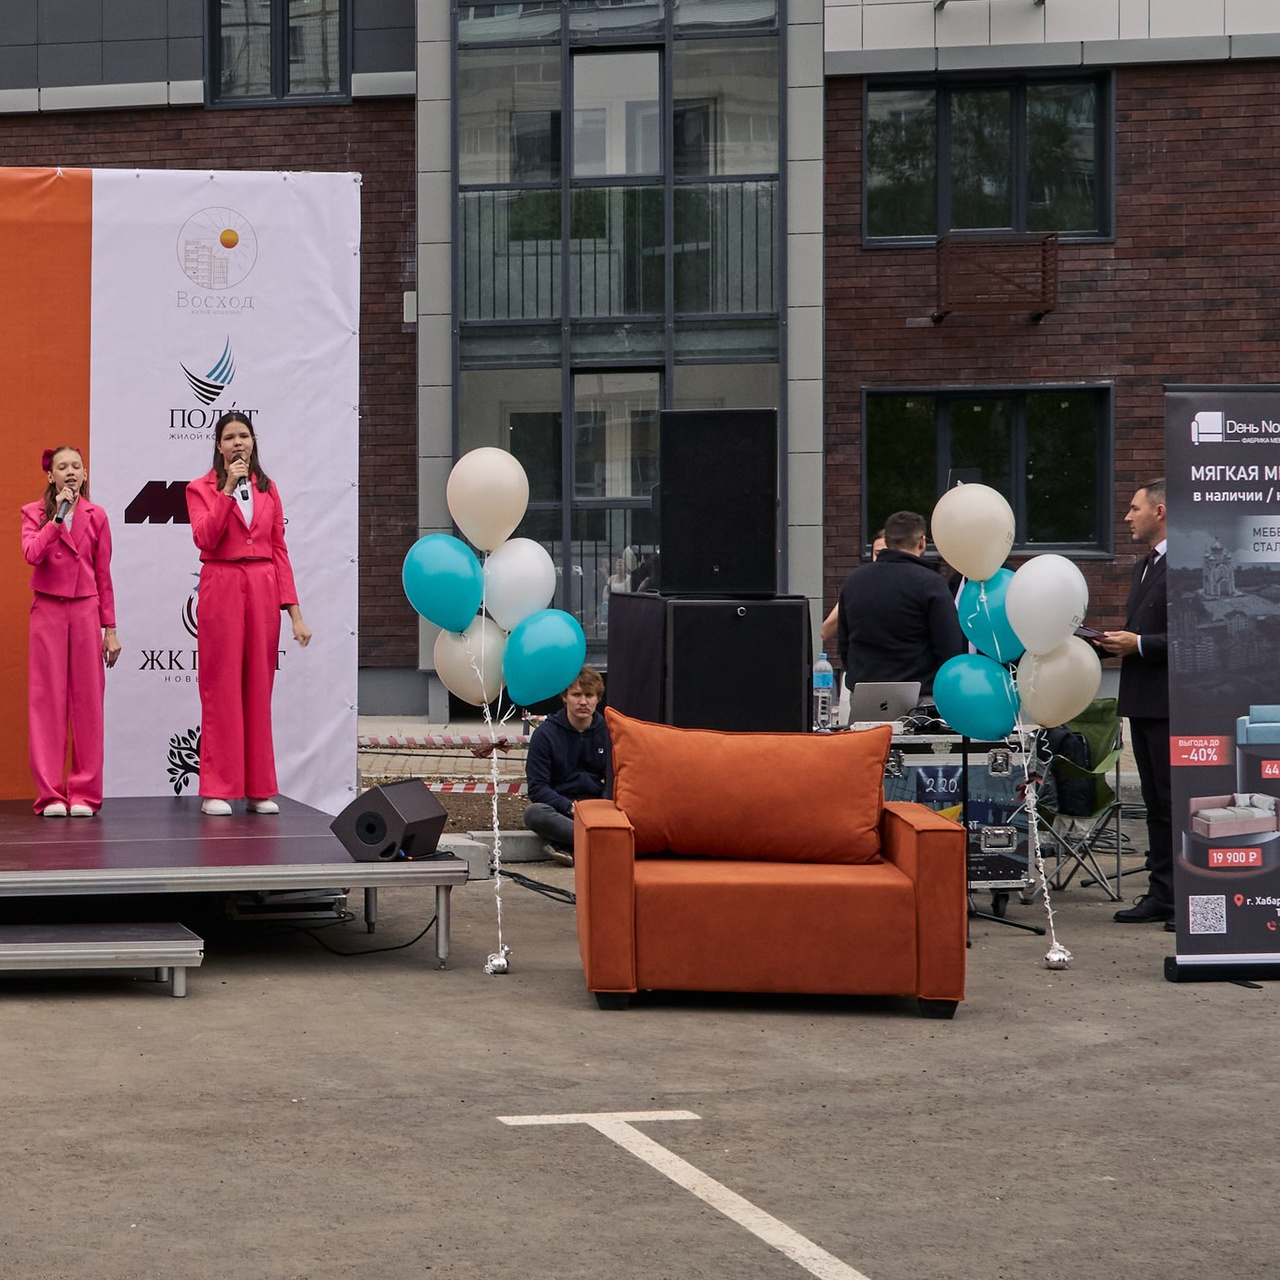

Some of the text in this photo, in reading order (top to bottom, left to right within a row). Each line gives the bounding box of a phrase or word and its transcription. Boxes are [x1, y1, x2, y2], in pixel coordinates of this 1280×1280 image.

[176, 291, 255, 311] Восход
[169, 401, 259, 429] ПОЛТ
[1191, 465, 1259, 481] МЯГКАЯ
[1193, 491, 1202, 502] в
[1205, 491, 1263, 502] наличии
[139, 650, 185, 671] ЖК
[1178, 739, 1220, 747] ВЫГОДА ДО
[1265, 764, 1280, 775] 44
[1213, 853, 1224, 863] 19
[1226, 852, 1246, 863] 900
